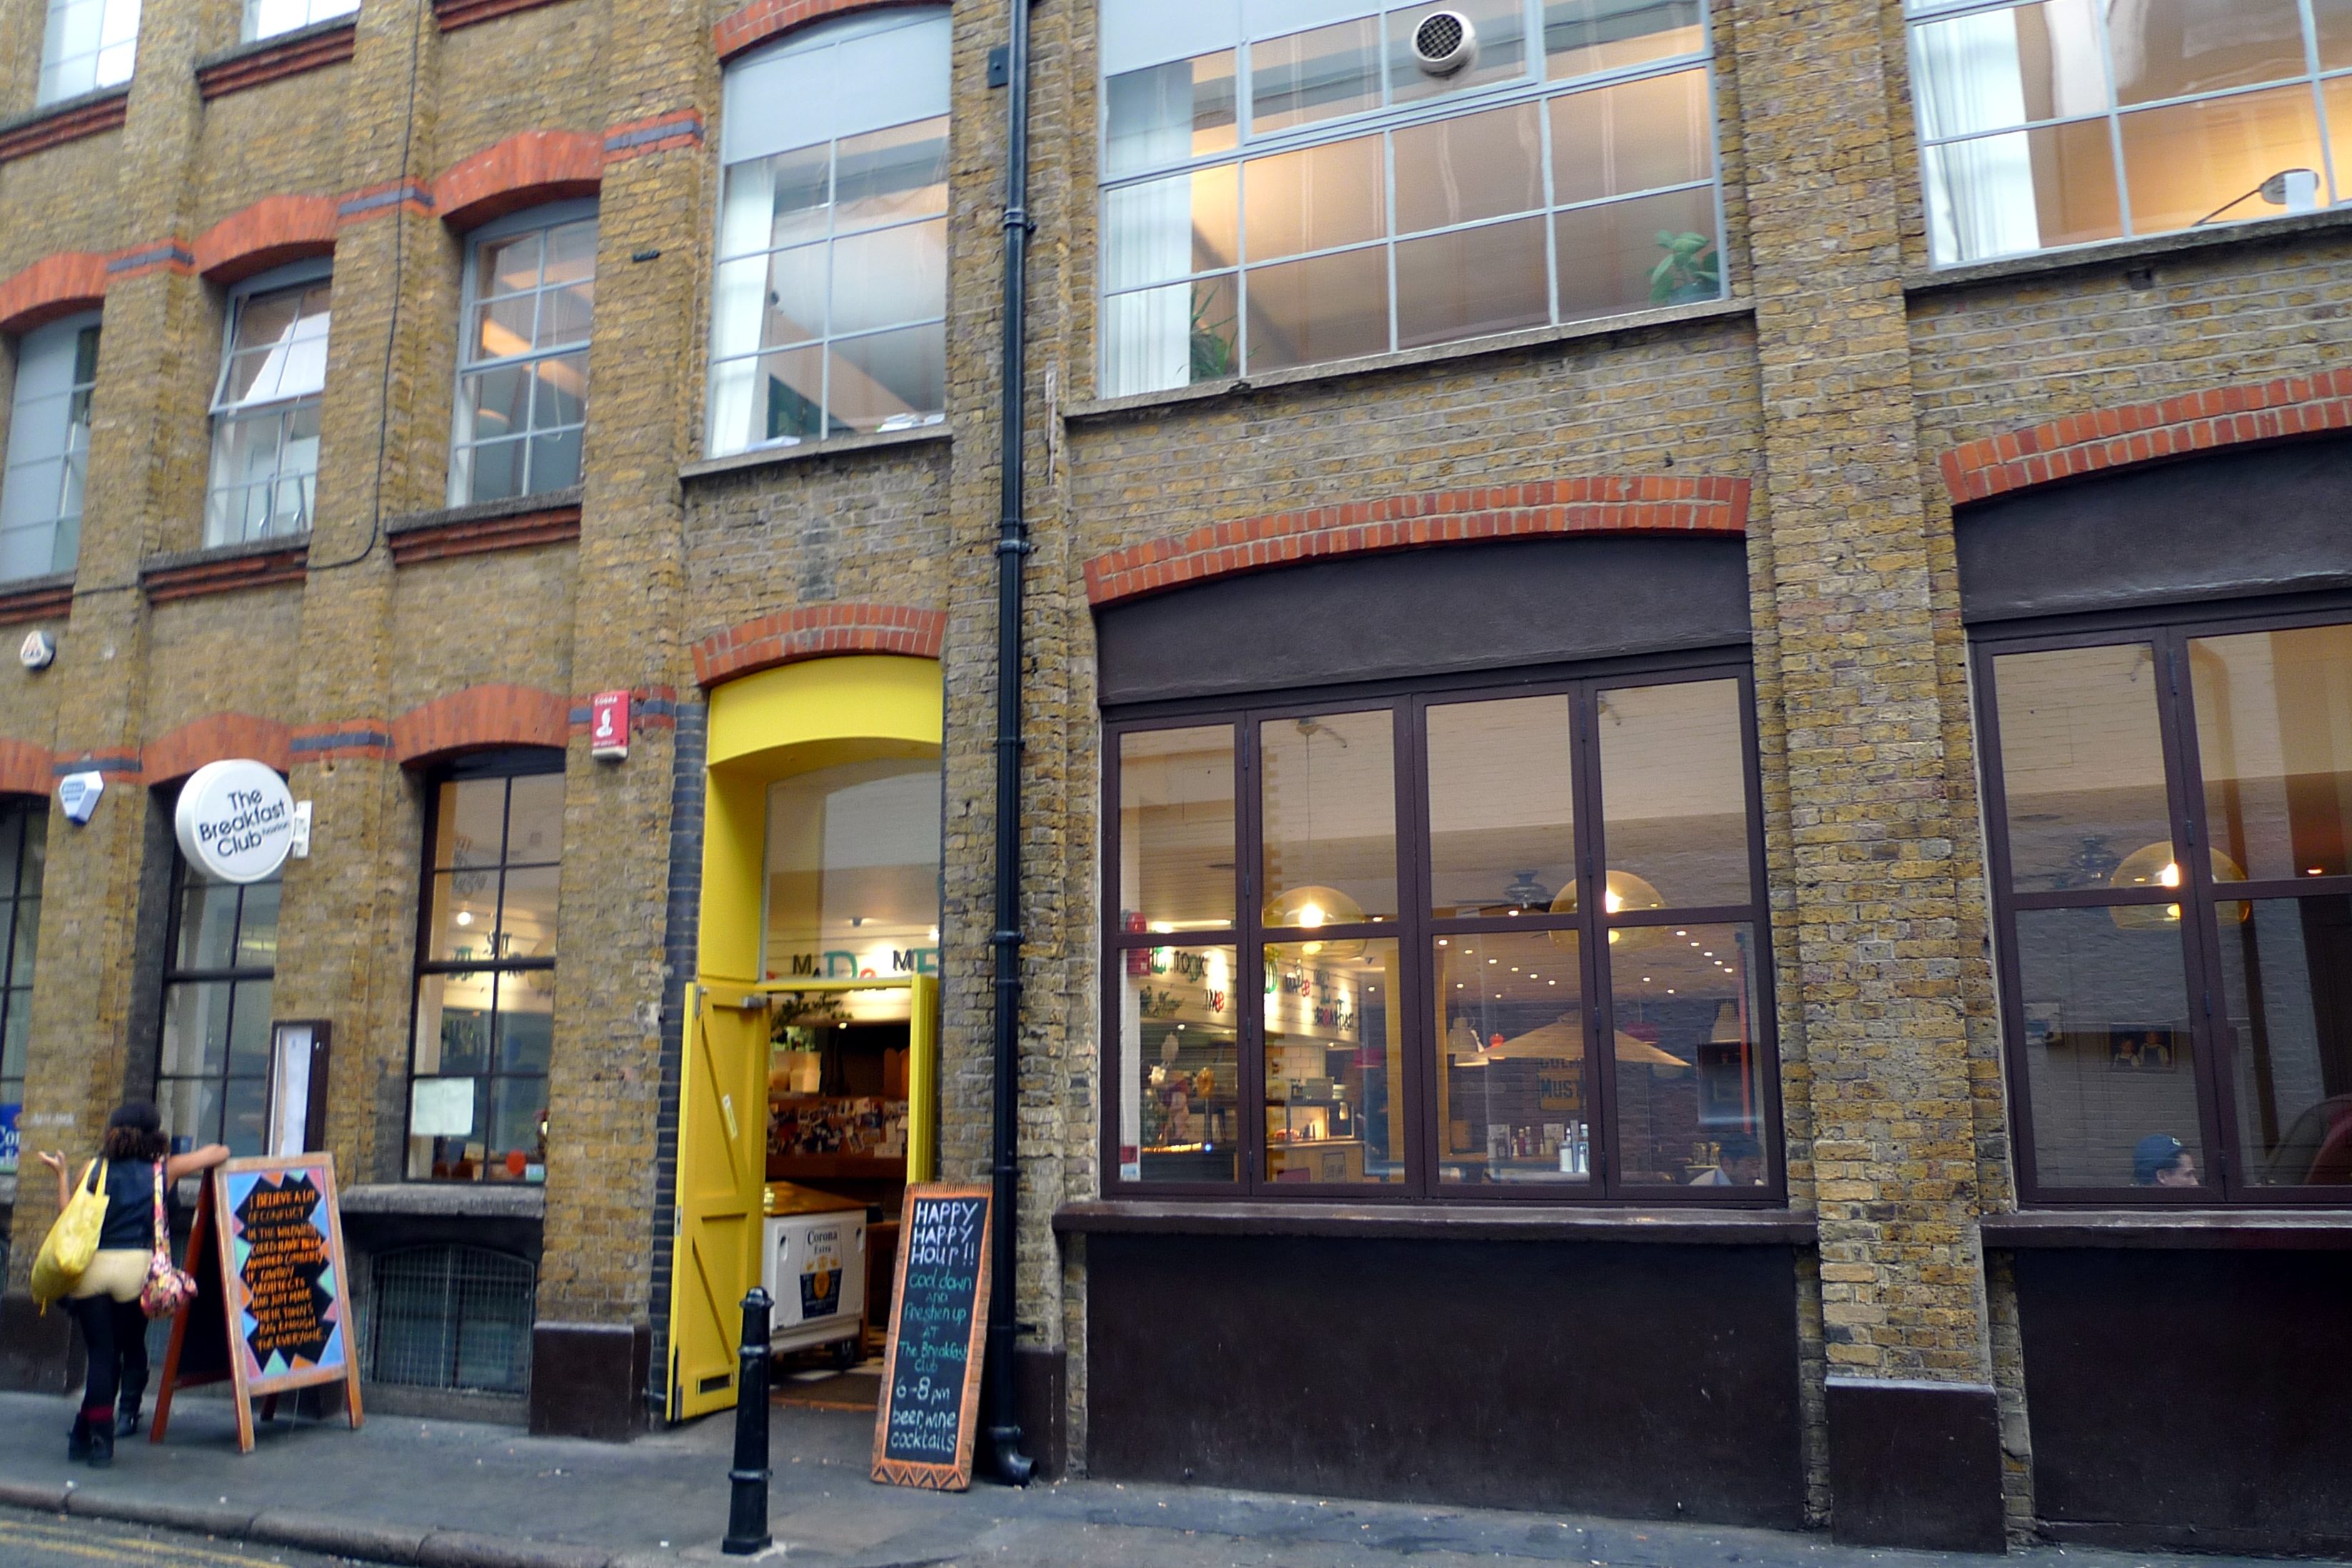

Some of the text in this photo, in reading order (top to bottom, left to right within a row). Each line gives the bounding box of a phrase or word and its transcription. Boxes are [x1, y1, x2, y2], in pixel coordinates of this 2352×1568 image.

[227, 789, 263, 810] The
[199, 798, 285, 842] Breakfast
[217, 830, 262, 857] Club
[256, 1191, 292, 1208] BELIEVE
[294, 1190, 301, 1202] A
[915, 1201, 978, 1225] HAPPY
[259, 1226, 274, 1239] THE
[807, 1230, 838, 1245] Corona
[913, 1224, 974, 1245] HAPPY
[909, 1267, 972, 1290] cool down
[953, 1308, 968, 1326] up
[923, 1325, 939, 1339] AT
[899, 1340, 968, 1361] The Breakfast
[914, 1358, 938, 1373] Club
[891, 1429, 956, 1452] cocktails
